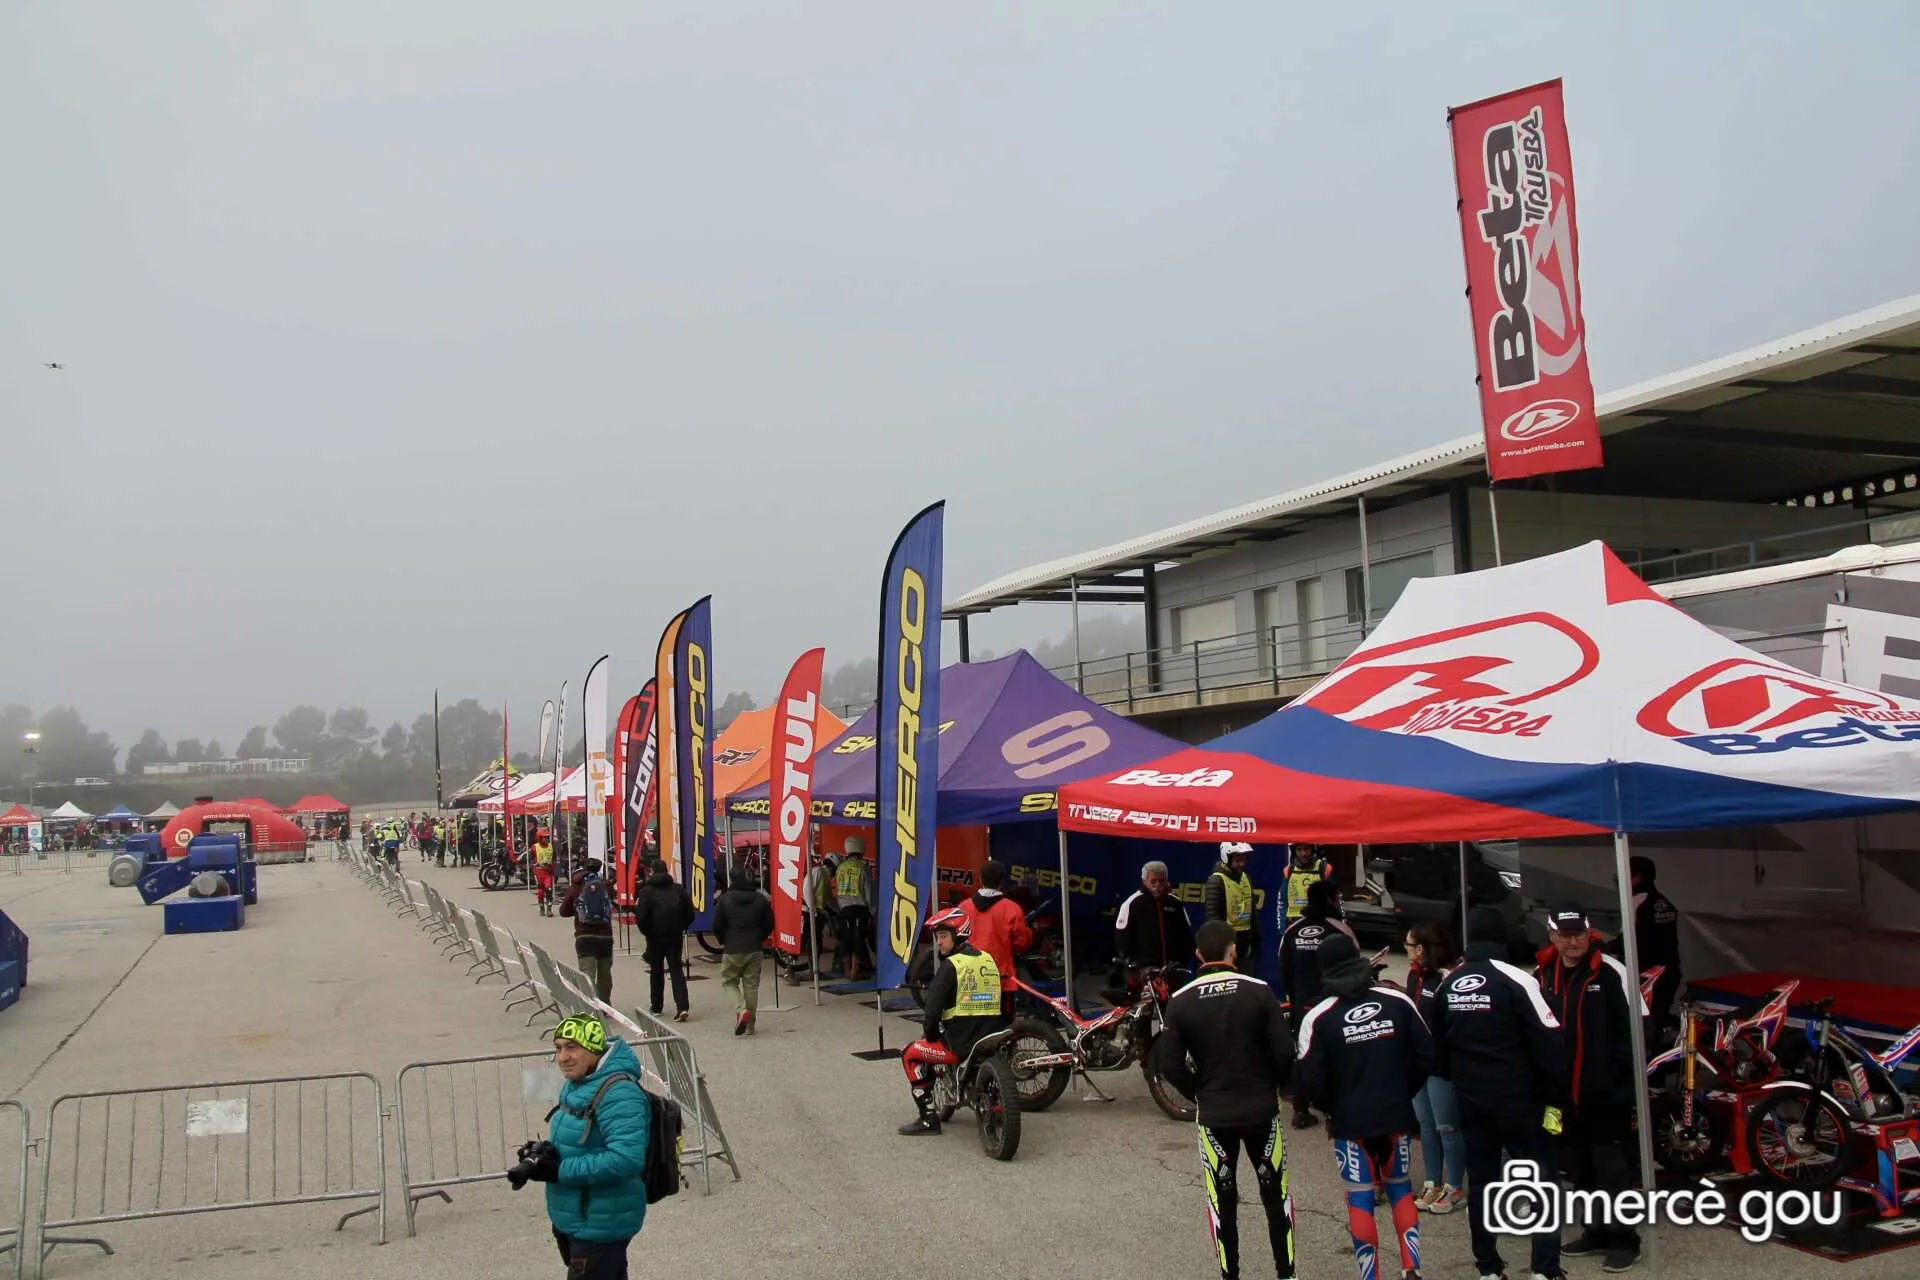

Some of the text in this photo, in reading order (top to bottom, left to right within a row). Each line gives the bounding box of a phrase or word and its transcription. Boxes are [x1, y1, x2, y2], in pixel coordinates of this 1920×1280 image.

[1479, 122, 1540, 391] Beta
[890, 567, 926, 965] SHERCO
[1108, 767, 1234, 788] Beta
[778, 690, 816, 901] MOTUL
[1295, 937, 1323, 945] Bet
[1447, 992, 1491, 1003] Beta
[1342, 1020, 1394, 1037] Beta
[914, 1042, 946, 1056] Montesa
